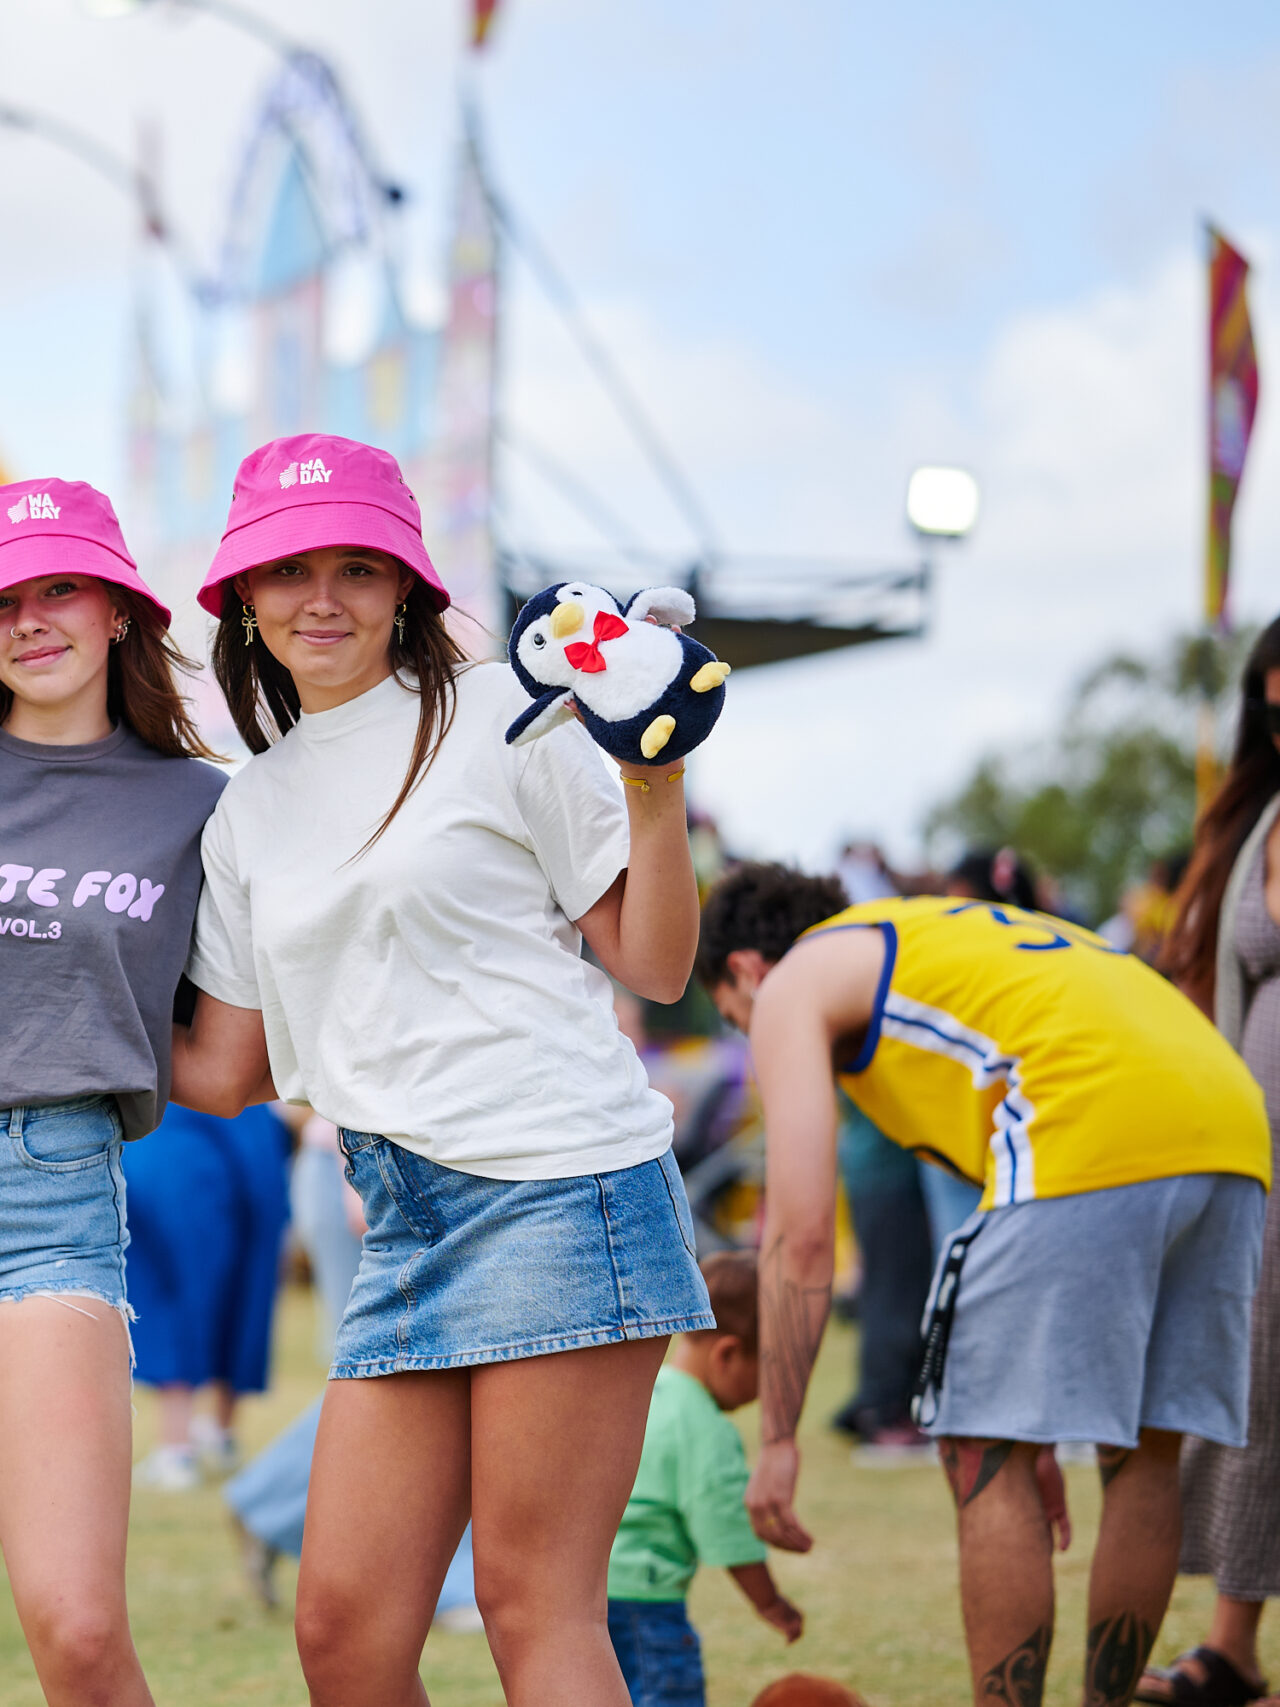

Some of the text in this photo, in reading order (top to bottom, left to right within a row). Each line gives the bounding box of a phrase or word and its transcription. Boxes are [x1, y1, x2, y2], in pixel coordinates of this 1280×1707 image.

[300, 458, 326, 470] WA
[299, 469, 333, 485] DAY
[28, 493, 55, 507] WA
[30, 506, 61, 519] DAY
[72, 870, 166, 922] FOX
